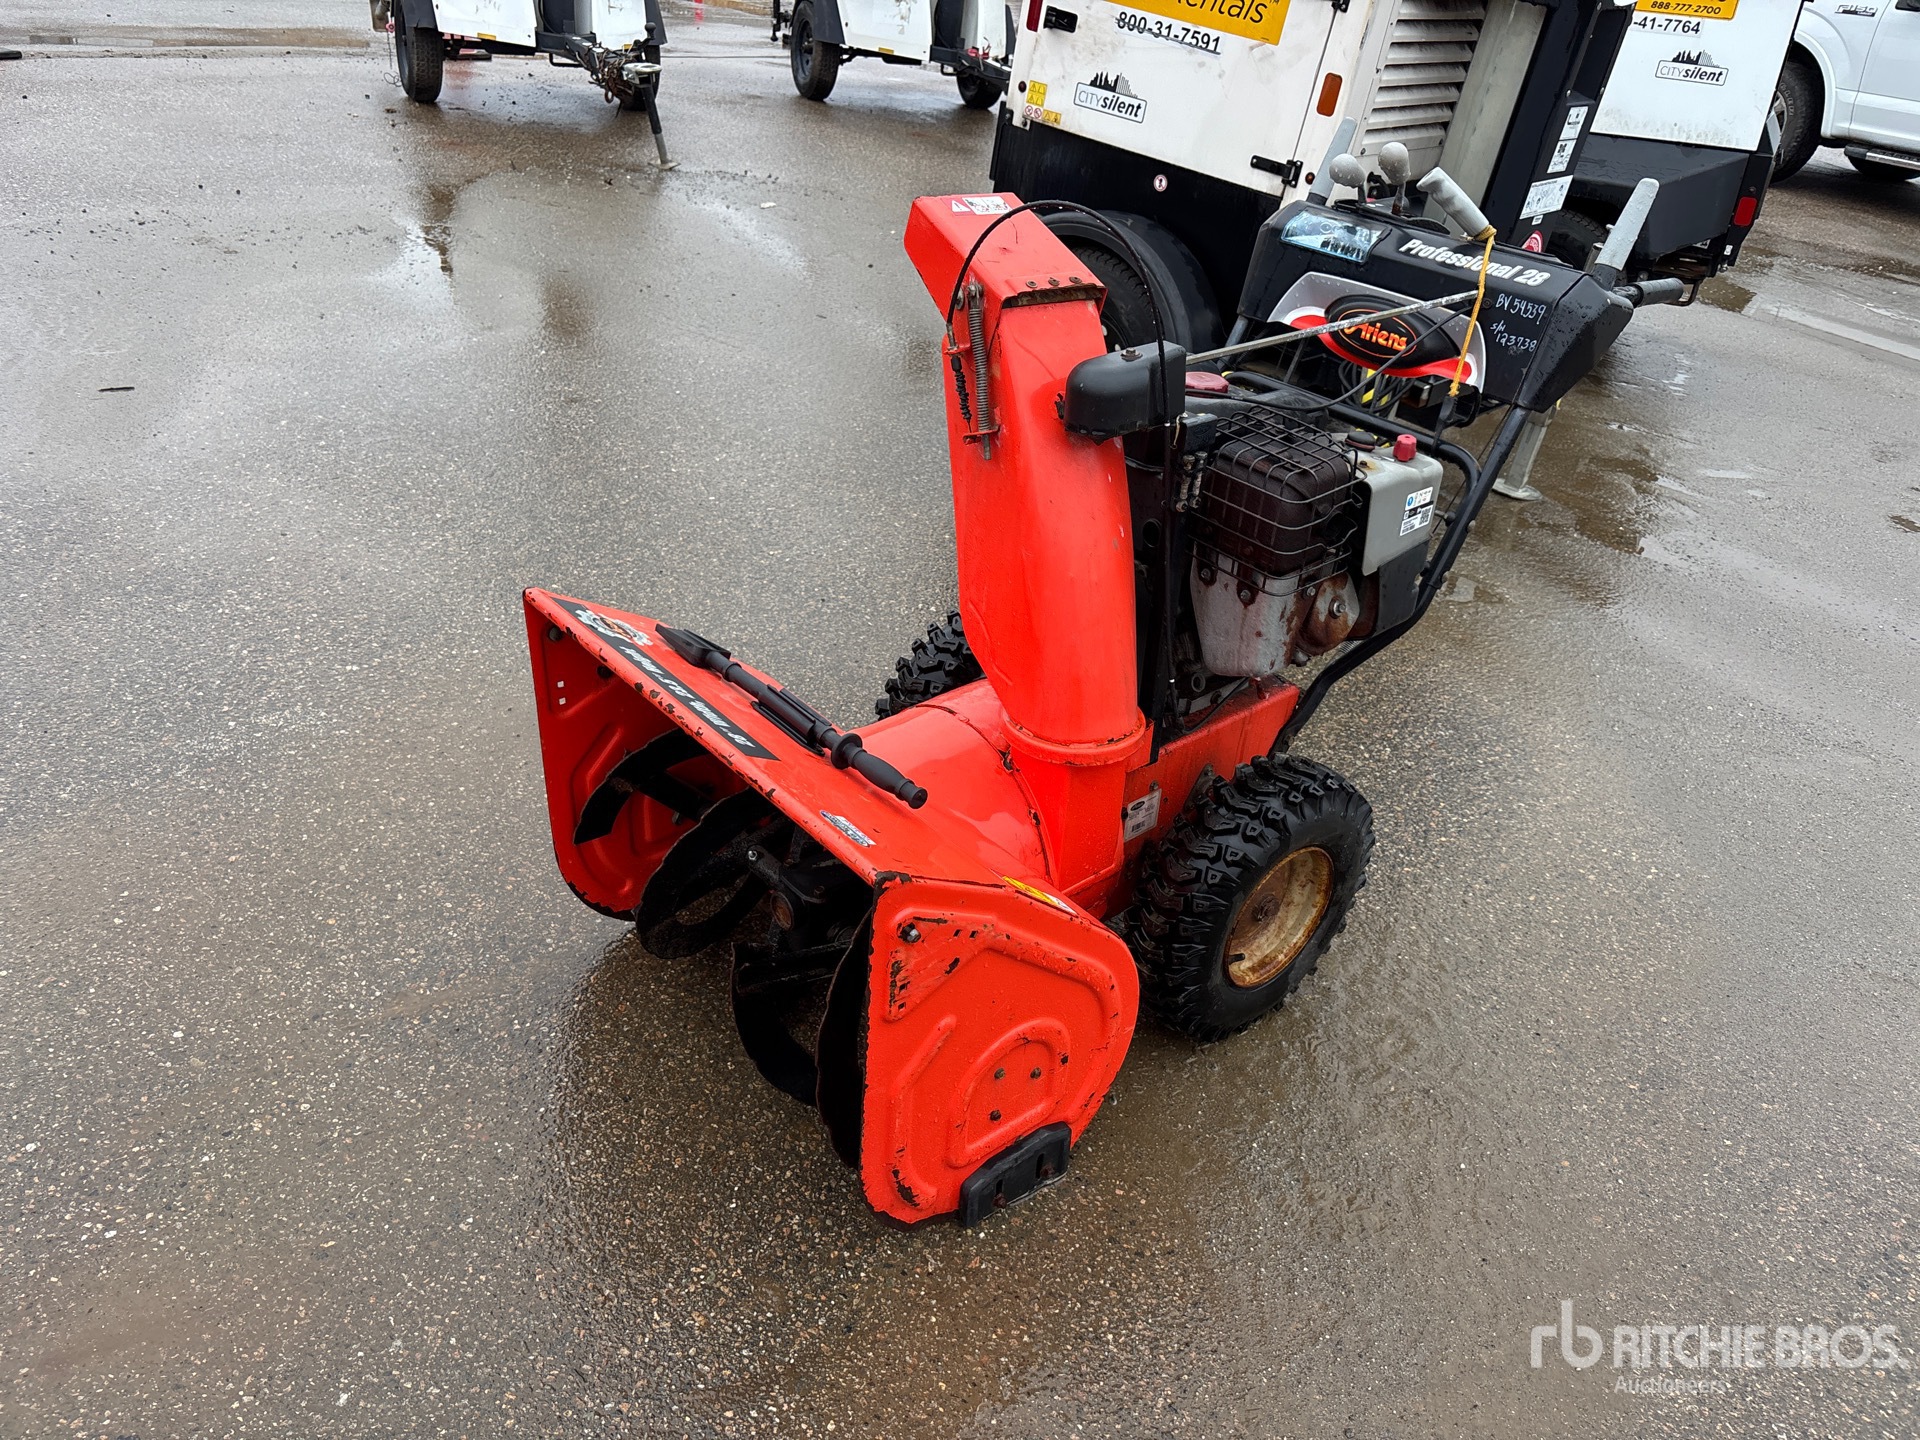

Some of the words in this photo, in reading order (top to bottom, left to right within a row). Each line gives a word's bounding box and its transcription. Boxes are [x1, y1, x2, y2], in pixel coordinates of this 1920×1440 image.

[1650, 0, 1722, 15] 888-777-2700
[1115, 11, 1221, 54] 800-31-7591
[1660, 66, 1723, 83] CITYsilent
[1078, 90, 1142, 118] CITYsilent
[1398, 238, 1523, 280] Professional
[1513, 269, 1551, 287] 28
[1343, 322, 1408, 352] Ariens
